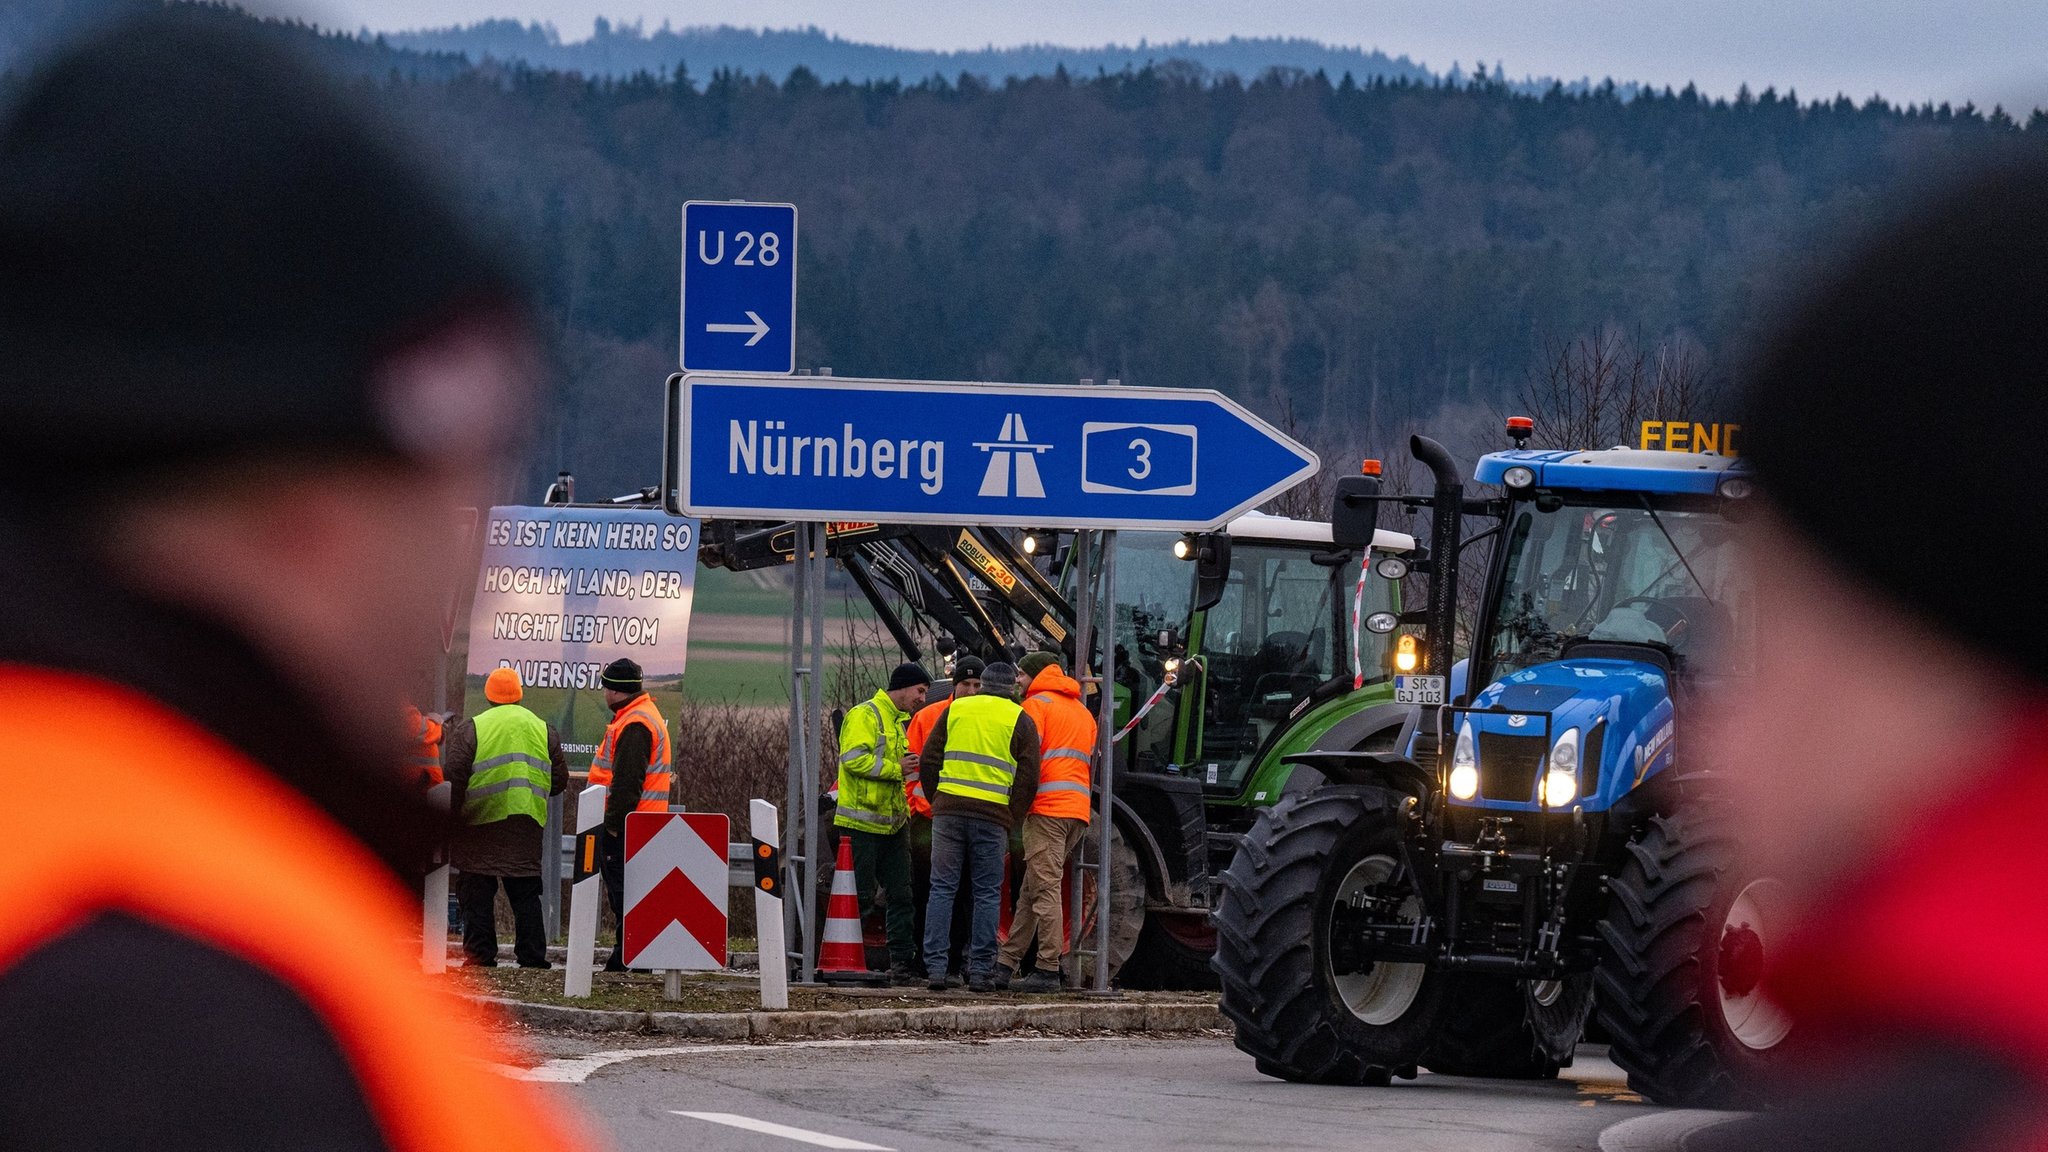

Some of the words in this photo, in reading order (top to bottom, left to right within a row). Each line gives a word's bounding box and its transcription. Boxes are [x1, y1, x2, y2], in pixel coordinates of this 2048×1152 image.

[699, 230, 725, 266] U
[734, 231, 780, 267] 28
[729, 419, 945, 496] Nürnberg
[1127, 438, 1152, 480] 3
[488, 519, 512, 547] ES
[513, 520, 551, 548] IST
[552, 520, 602, 549] KEIN
[604, 521, 658, 551] HERR
[661, 522, 692, 552] SO
[960, 539, 991, 567] ROBUST
[484, 565, 544, 594] HOCH
[547, 567, 574, 595] IM
[576, 567, 636, 600] LAND,
[639, 570, 682, 599] DER
[493, 612, 559, 641] NICHT
[561, 614, 609, 643] LEBT
[612, 616, 660, 646] VOM
[499, 659, 609, 691] AUERNST
[1412, 677, 1428, 690] SR
[1397, 690, 1414, 703] GJ
[1418, 691, 1441, 703] 103
